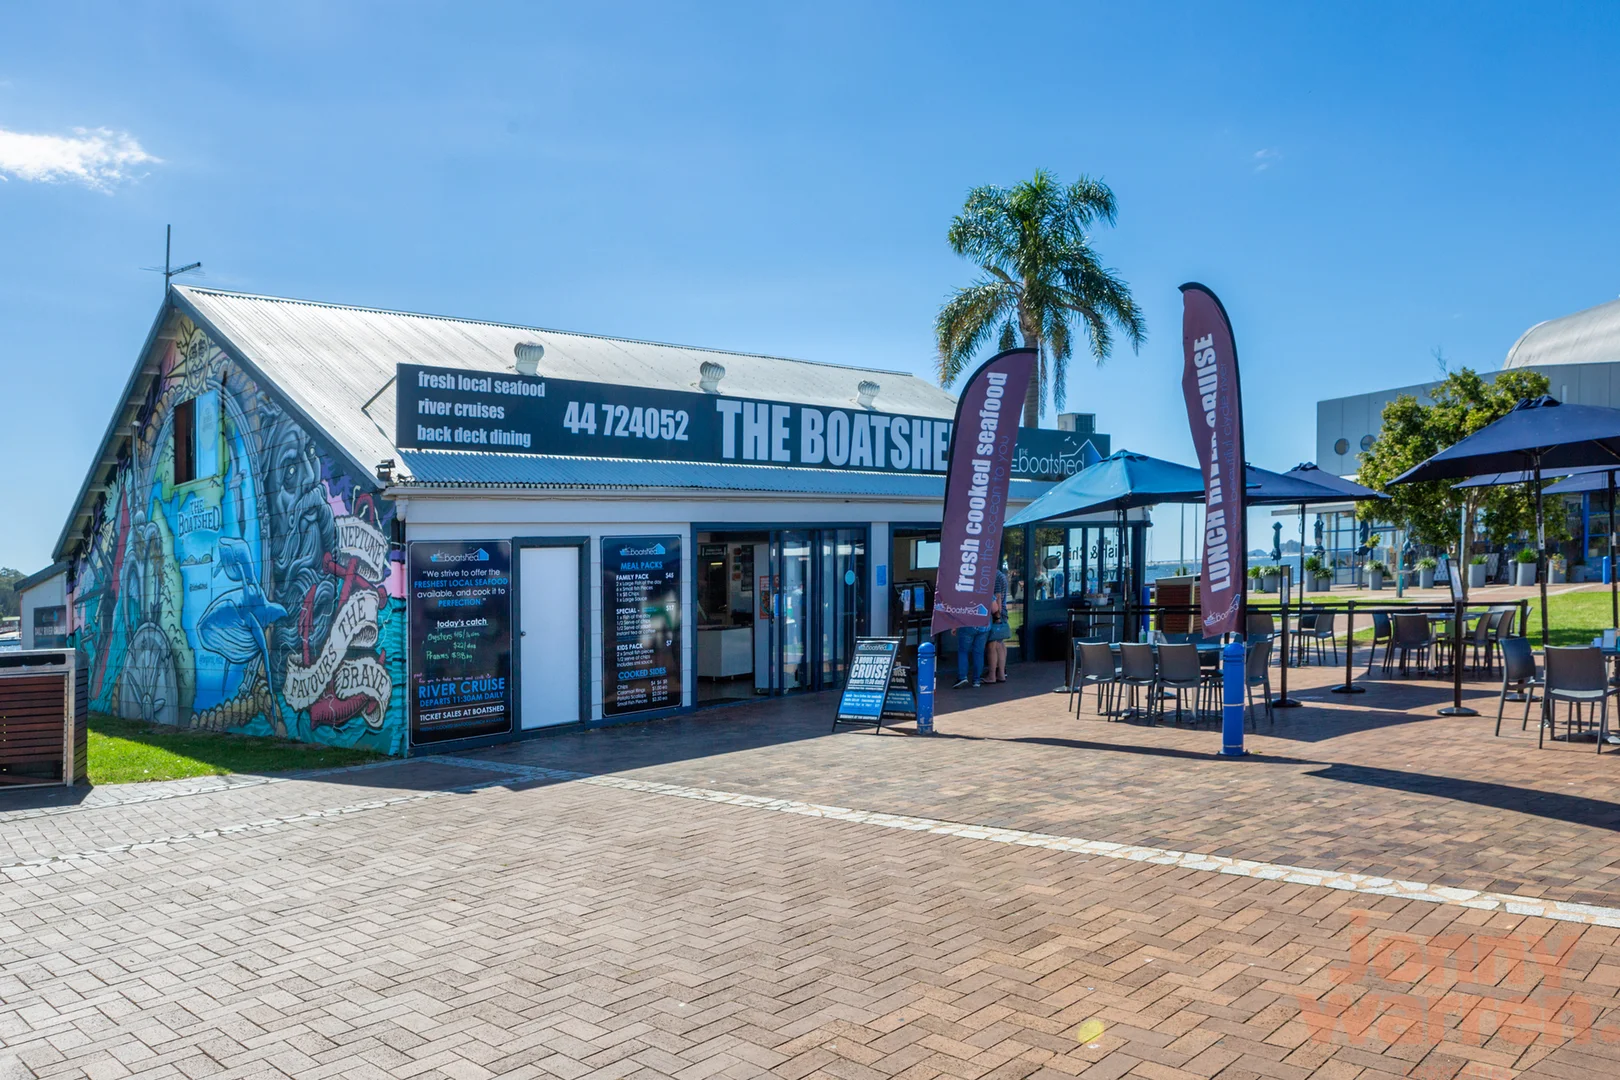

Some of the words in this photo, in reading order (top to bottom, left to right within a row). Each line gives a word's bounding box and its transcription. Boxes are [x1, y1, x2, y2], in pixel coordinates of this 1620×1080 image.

[418, 371, 455, 391] fresh
[458, 374, 491, 393] local
[494, 378, 546, 398] seafood
[1220, 364, 1228, 396] river
[418, 398, 452, 416] river
[454, 402, 504, 419] cruises
[563, 401, 596, 434] 44
[602, 404, 689, 441] 724052
[976, 372, 1008, 457] seafood
[417, 424, 451, 442] back
[454, 426, 487, 444] deck
[490, 429, 531, 448] dining
[716, 399, 790, 462] THE
[801, 408, 954, 471] BOATSHE
[998, 435, 1009, 463] you
[1018, 449, 1084, 475] boatshed
[993, 467, 1004, 484] to
[190, 499, 204, 515] THE
[965, 459, 992, 536] cooked
[988, 486, 1002, 533] ocean
[178, 506, 220, 537] BOATSHED
[341, 526, 384, 568] NEPTUNE
[981, 538, 995, 562] the
[1206, 508, 1230, 592] LUNCH
[620, 562, 639, 570] MEAL
[640, 561, 663, 569] PACKS
[955, 538, 981, 593] fresh
[414, 580, 448, 588] FRESHEST
[450, 579, 472, 587] LOCAL
[474, 578, 508, 586] SEAFOOD
[456, 588, 471, 596] and
[472, 588, 490, 596] cook
[976, 567, 990, 595] from
[437, 619, 464, 628] today's
[466, 618, 488, 626] catch
[290, 644, 338, 698] FAVOURS
[338, 598, 366, 638] THE
[342, 664, 390, 698] BRAVE
[618, 669, 648, 680] COOKED
[650, 666, 667, 676] SIDES
[850, 664, 888, 678] CRUISE
[418, 683, 456, 698] RIVER
[460, 678, 505, 694] CRUISE
[420, 697, 450, 707] DEPARTS
[453, 694, 482, 704] 11:30AM
[484, 691, 504, 700] DAILY
[420, 712, 442, 722] TICKET
[442, 710, 462, 719] SALES
[472, 705, 504, 714] BOATSHED
